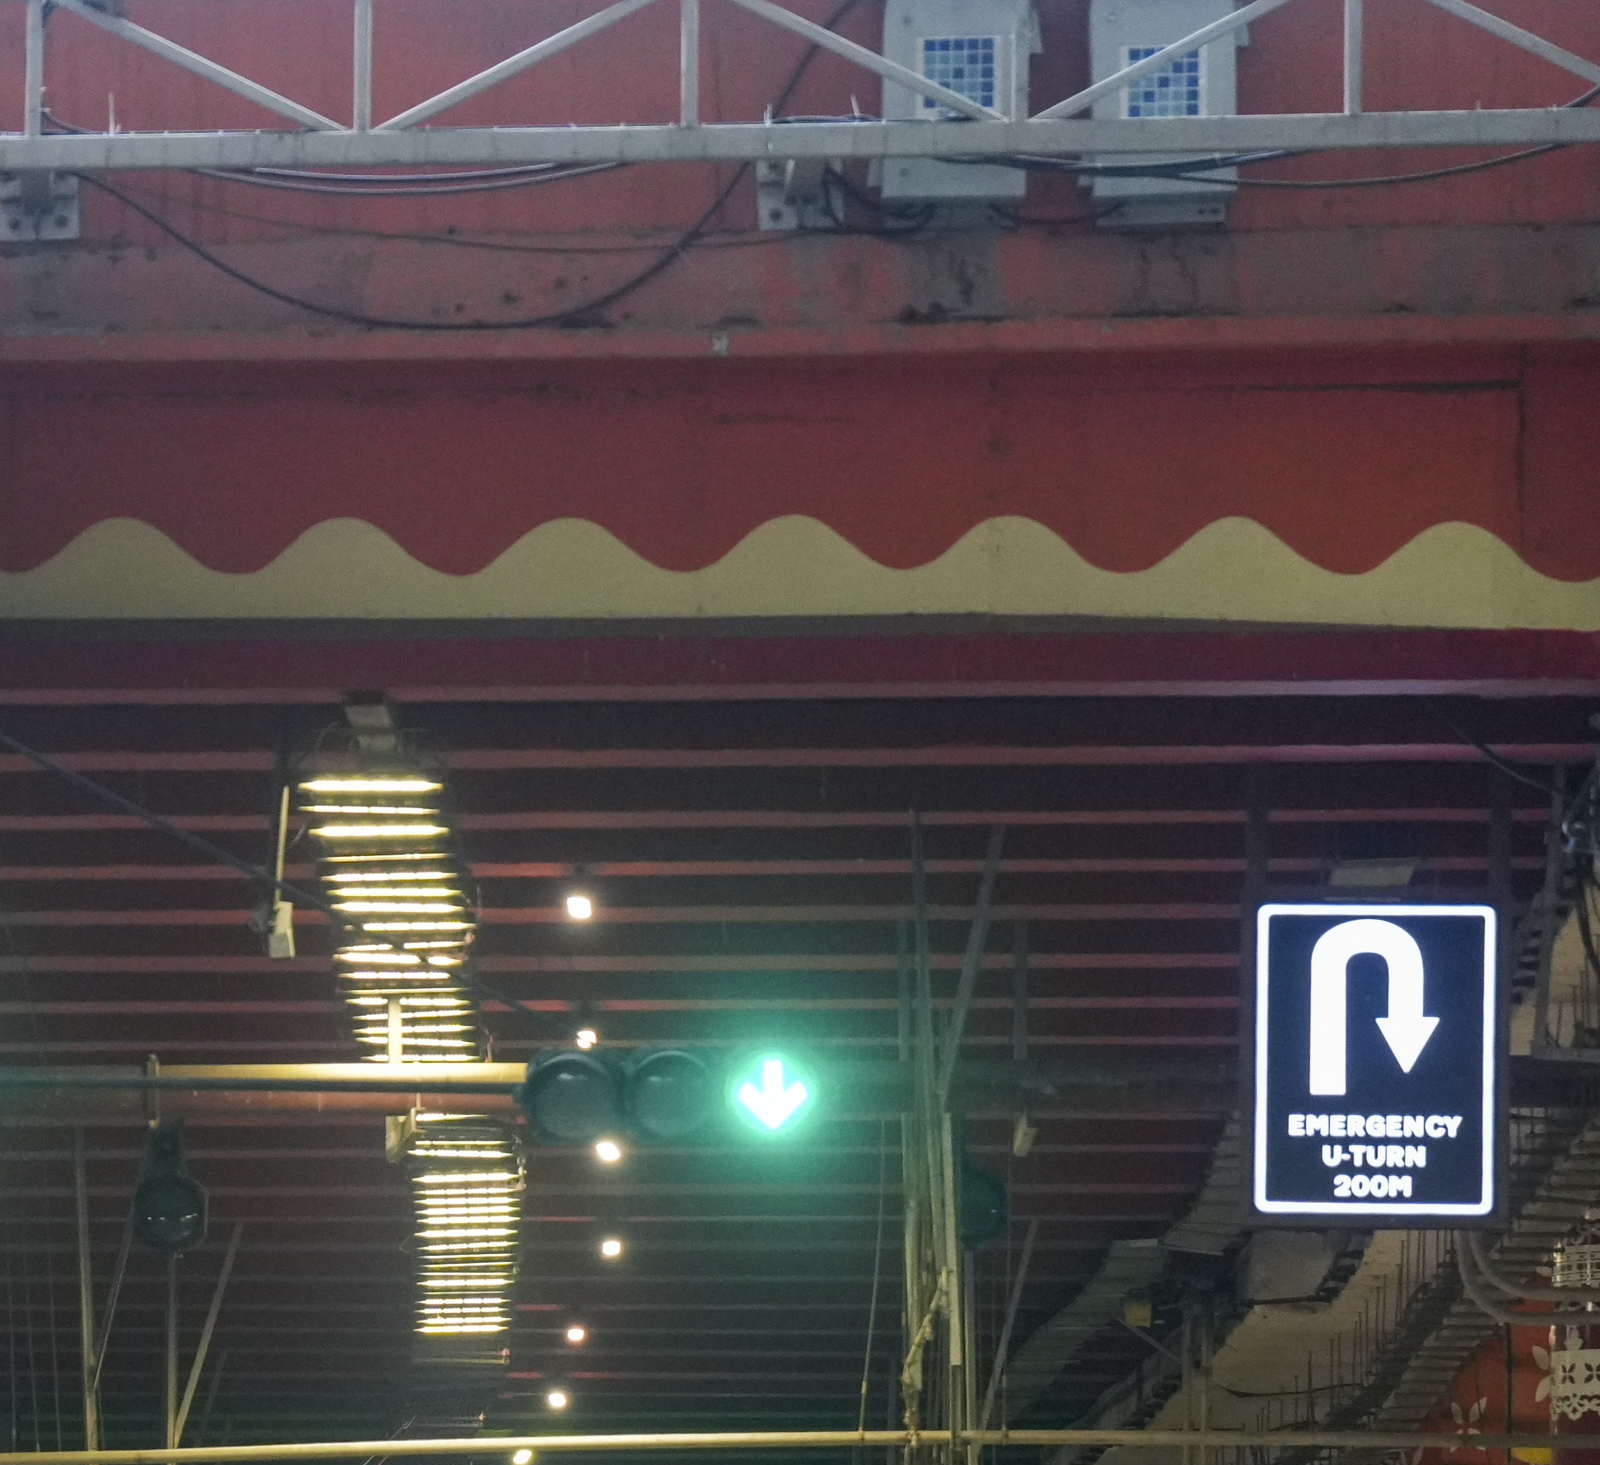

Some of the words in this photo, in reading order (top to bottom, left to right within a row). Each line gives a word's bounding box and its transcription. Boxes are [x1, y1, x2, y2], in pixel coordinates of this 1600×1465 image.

[1287, 1113, 1463, 1139] EMERGENCY
[1321, 1144, 1427, 1168] U-TURN
[1333, 1174, 1413, 1198] 200M
